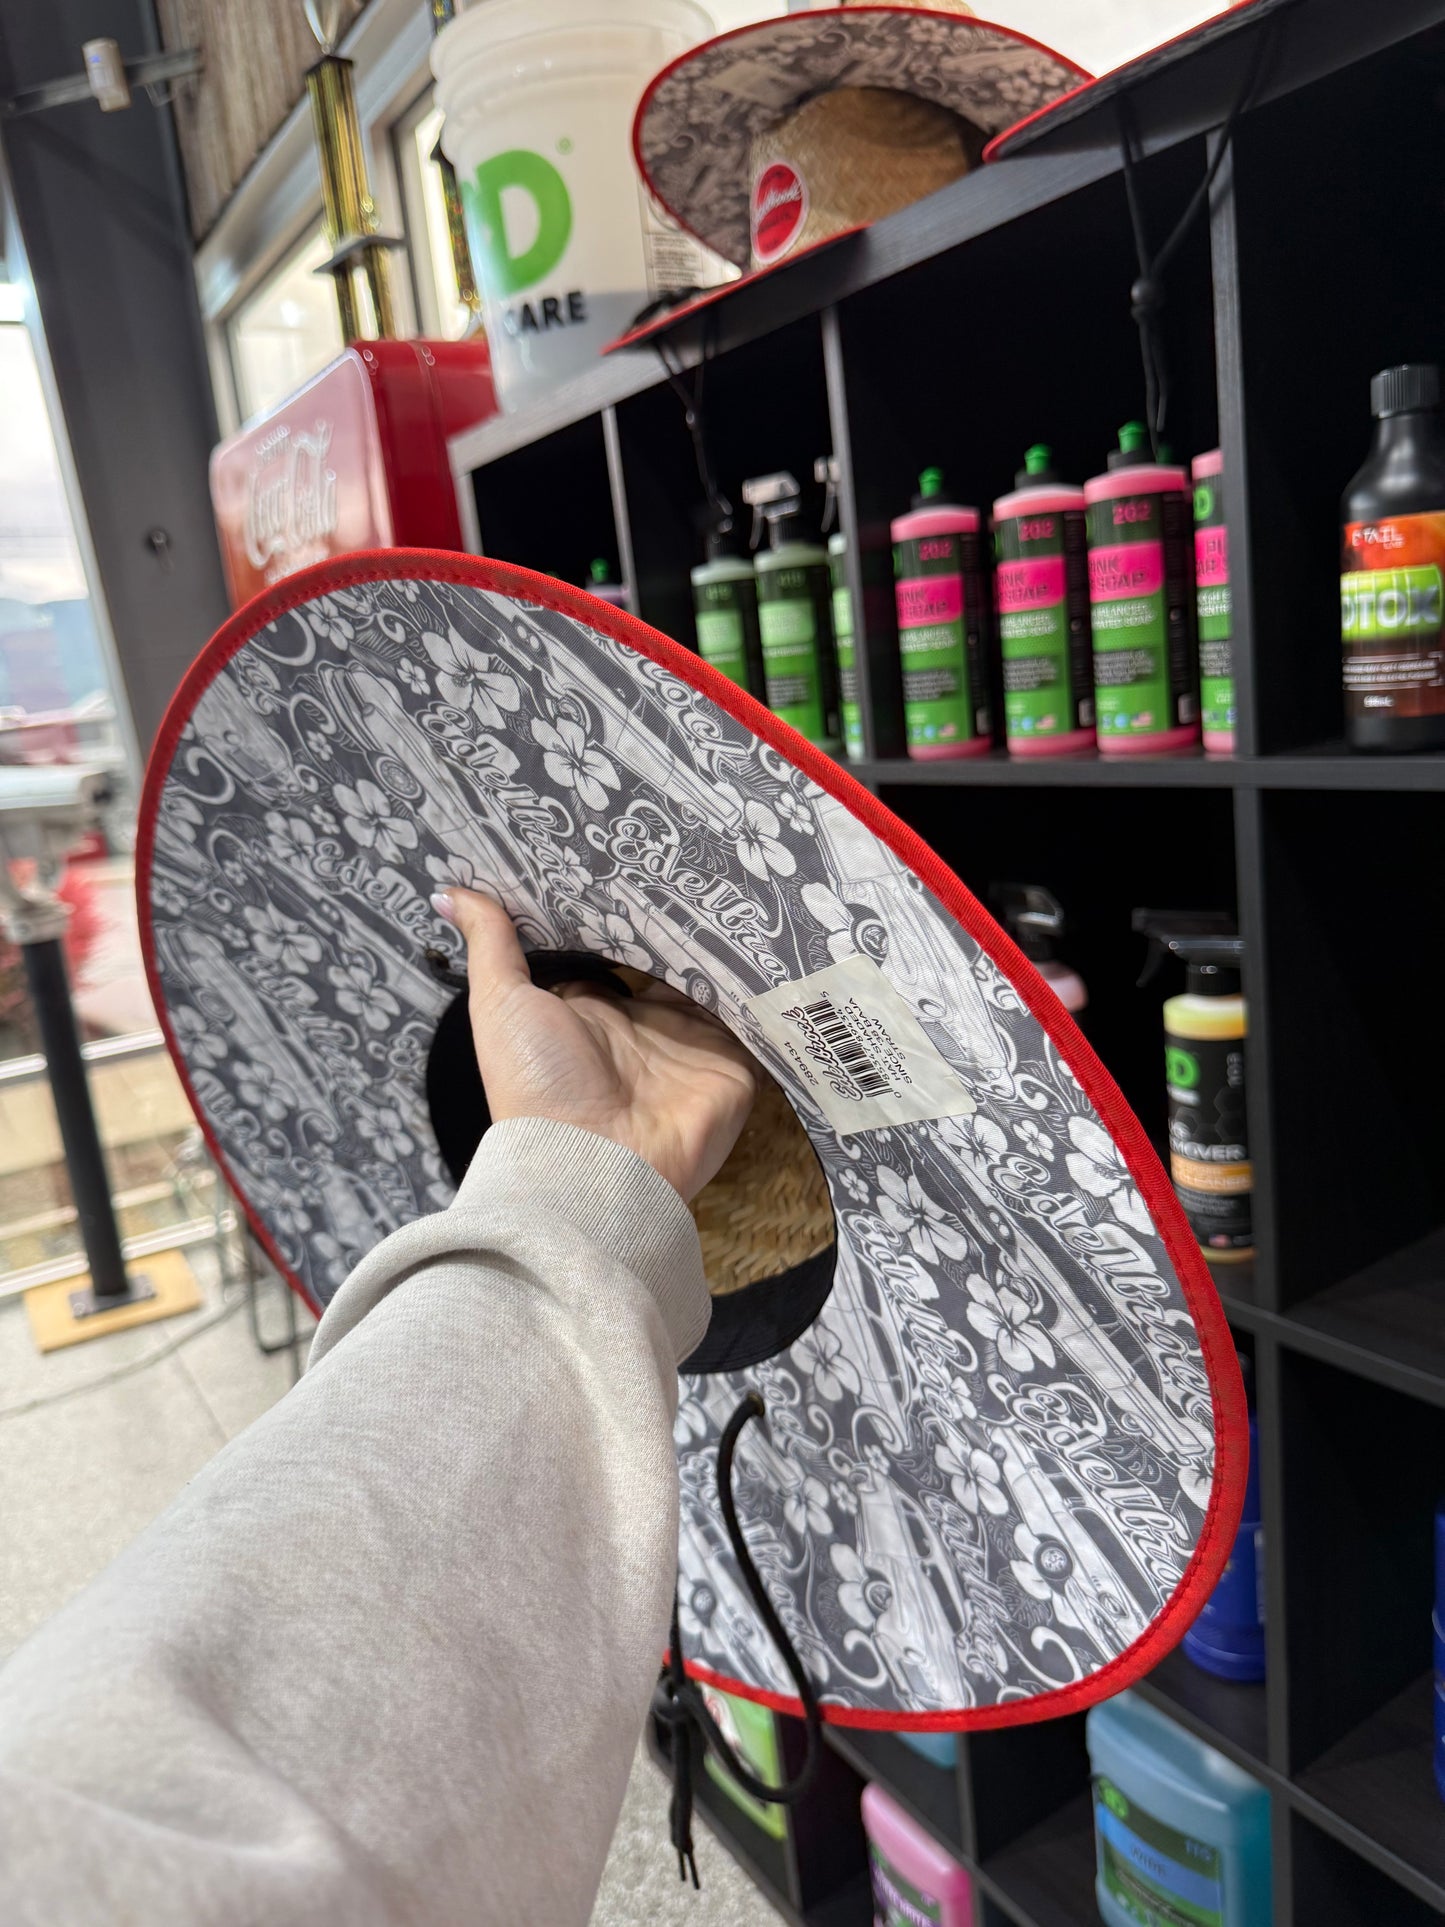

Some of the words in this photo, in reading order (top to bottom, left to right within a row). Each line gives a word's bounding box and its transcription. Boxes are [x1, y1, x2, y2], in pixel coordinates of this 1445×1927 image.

[819, 990, 830, 999] 5
[848, 997, 874, 1029] BAJA
[844, 1005, 883, 1055] SHADED
[870, 1017, 907, 1062] STRAW
[781, 1006, 864, 1102] Edelbrock
[784, 1041, 820, 1086] 289434
[885, 1049, 914, 1086] SINCE
